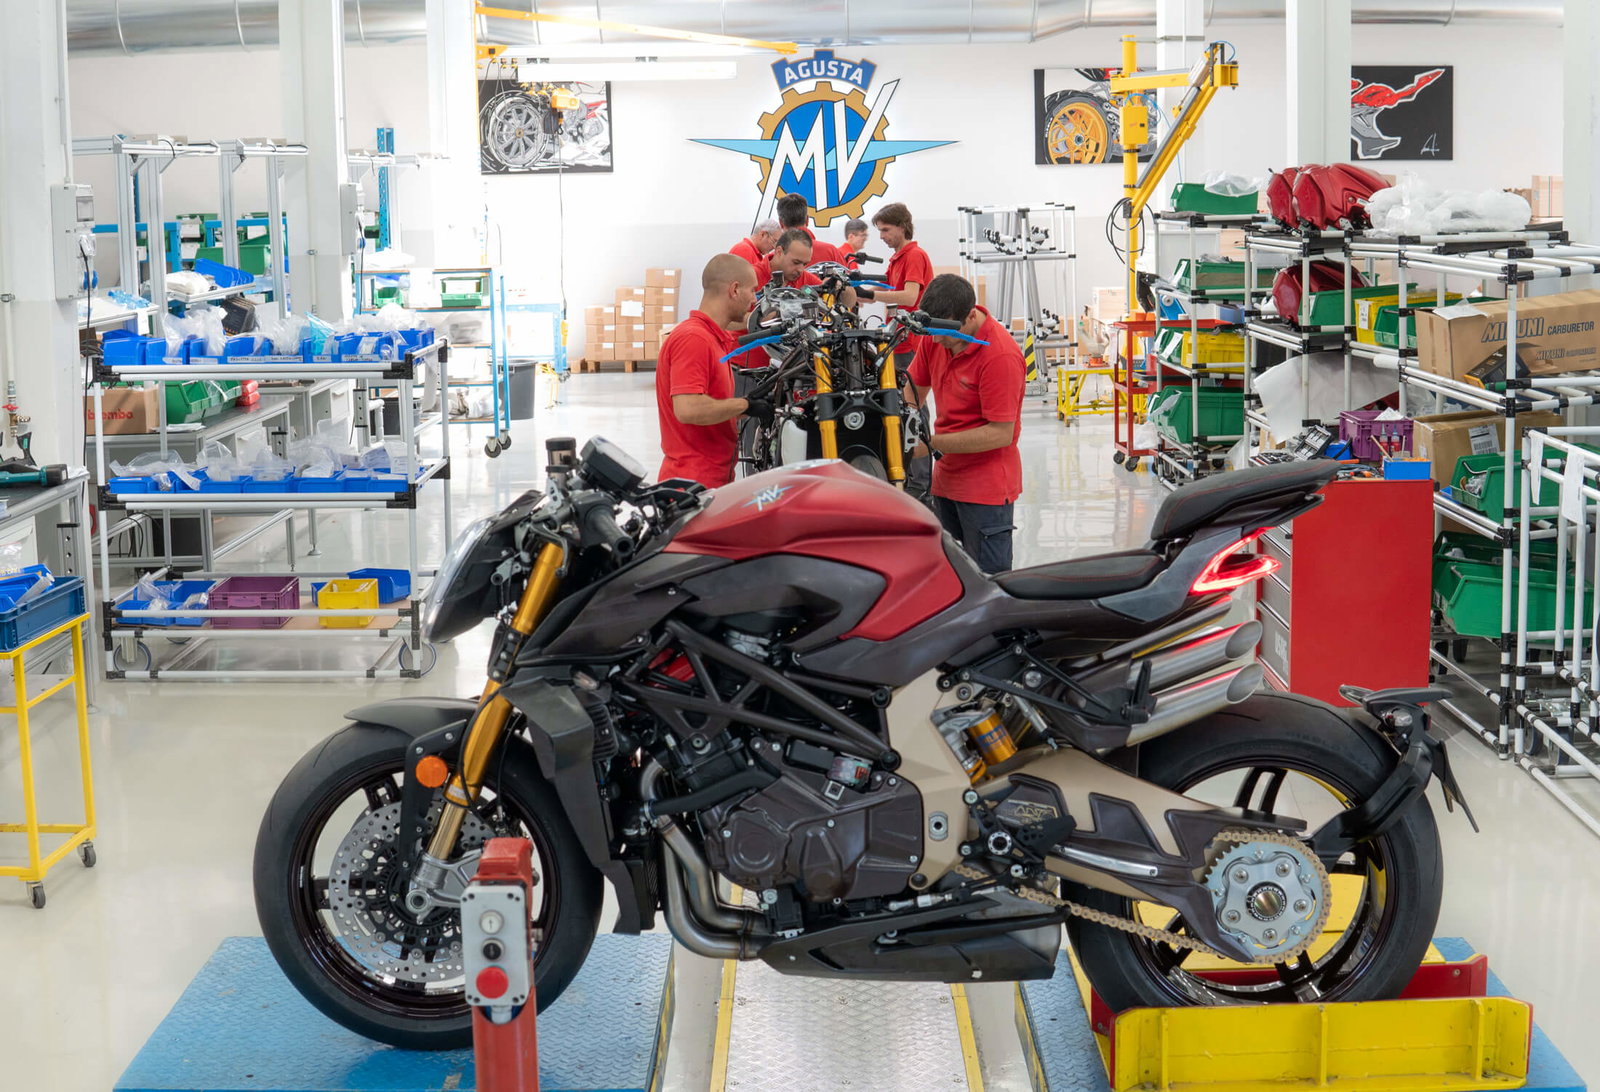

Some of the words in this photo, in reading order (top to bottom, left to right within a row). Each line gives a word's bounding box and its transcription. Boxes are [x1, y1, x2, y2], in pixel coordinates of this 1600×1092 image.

[784, 60, 863, 85] AGUSTA
[752, 79, 901, 235] MV
[1481, 318, 1544, 342] MIUNI
[1547, 321, 1594, 335] CARBURETOR
[88, 409, 133, 420] bembo
